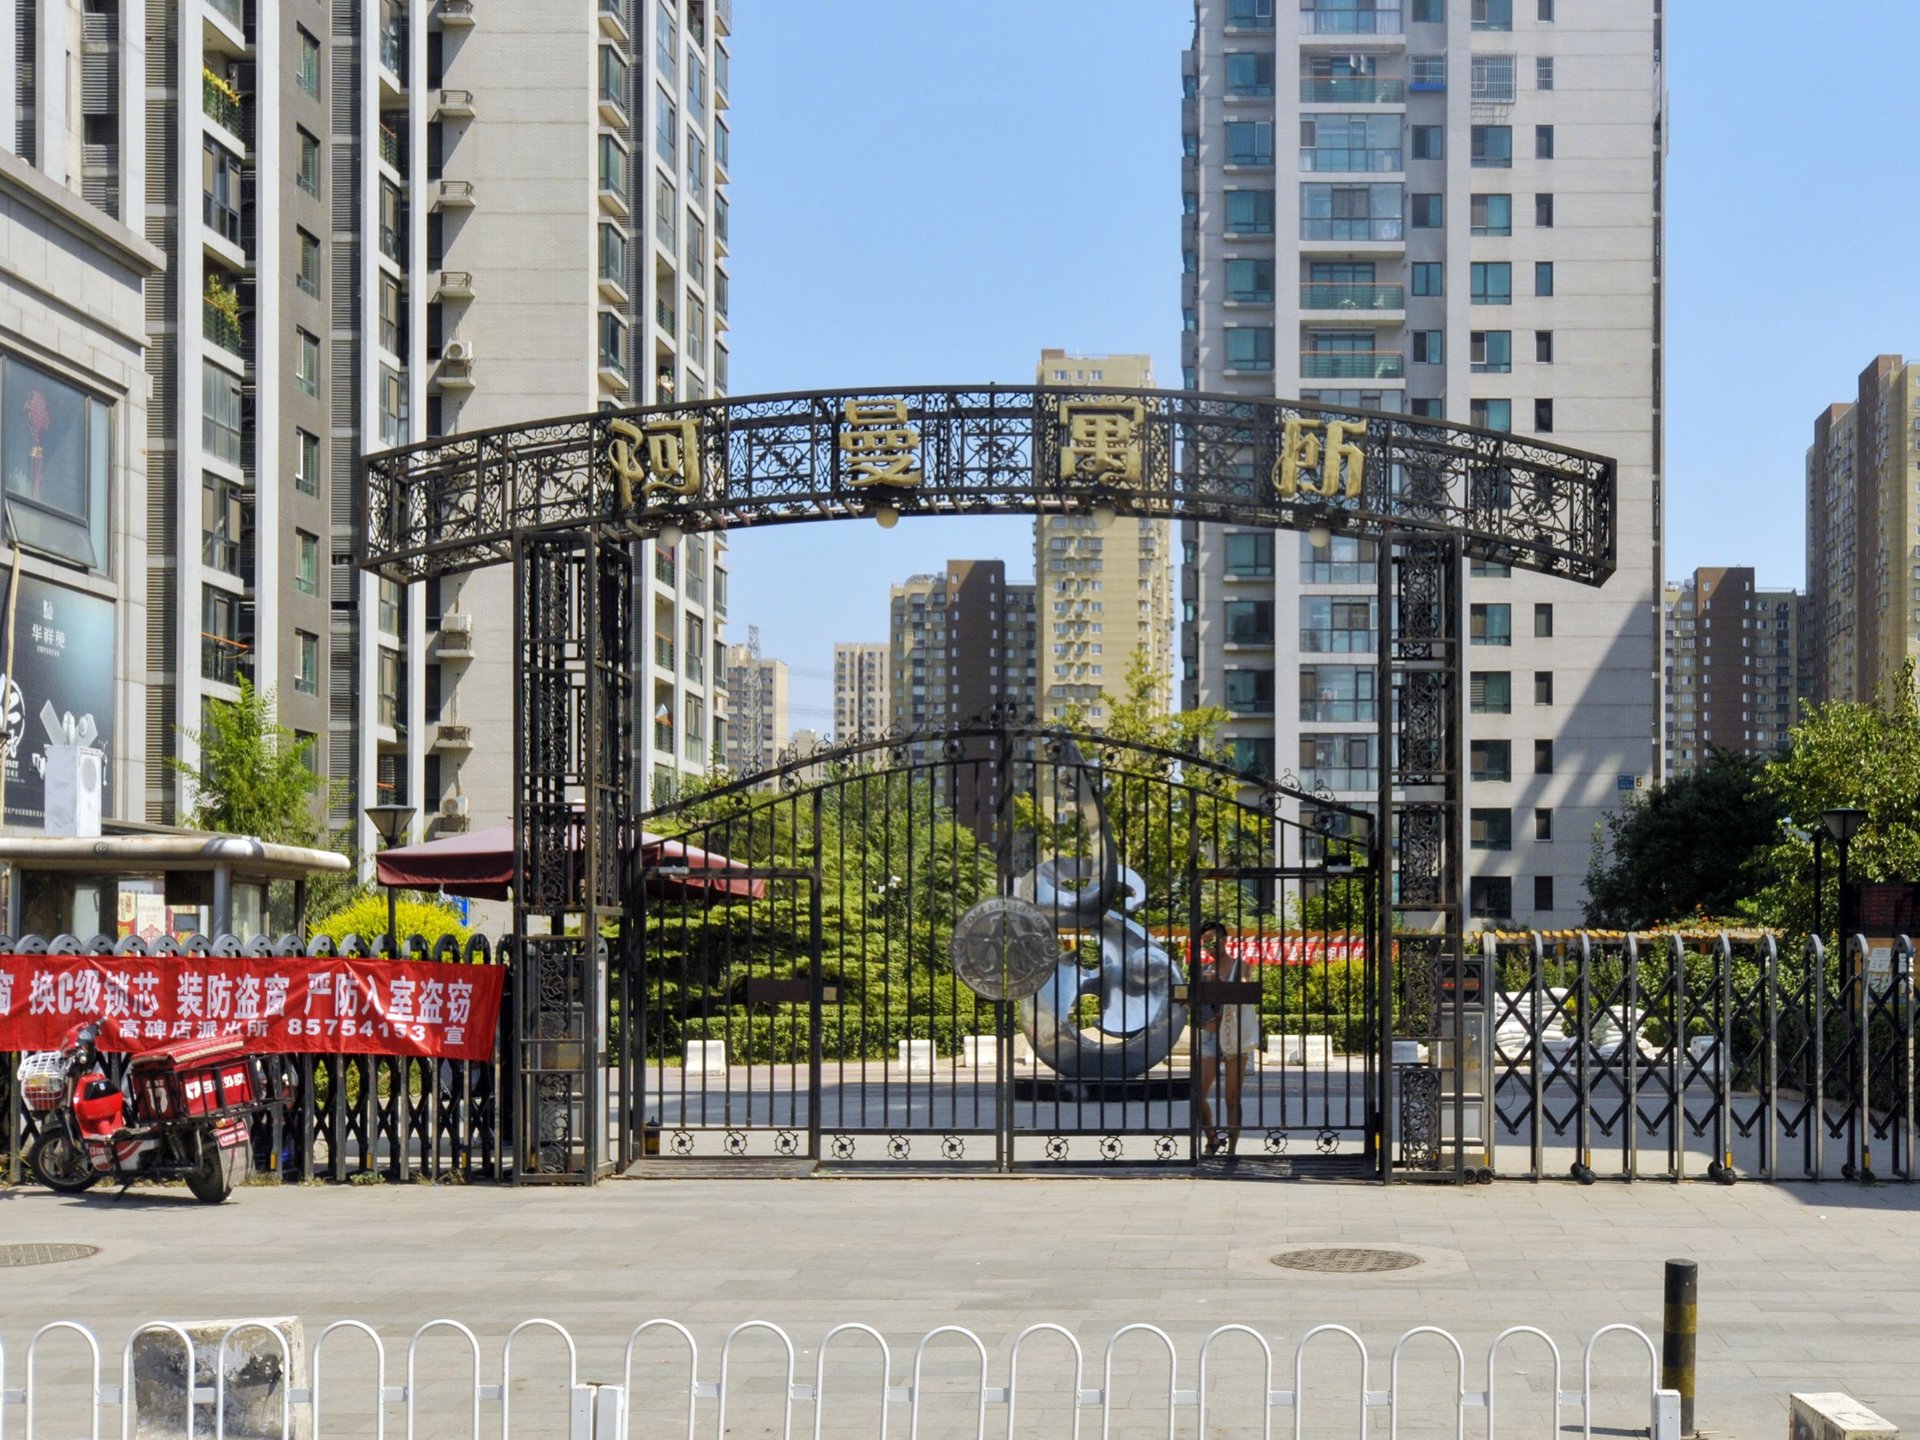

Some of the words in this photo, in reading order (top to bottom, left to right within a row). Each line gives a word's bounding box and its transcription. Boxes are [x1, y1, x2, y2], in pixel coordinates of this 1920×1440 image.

[29, 969, 160, 1017] 换C级锁芯
[177, 971, 290, 1019] 装防盗窗
[304, 971, 473, 1024] 严防入室盗窃
[287, 1017, 426, 1042] 85754153
[443, 1026, 465, 1045] 宣
